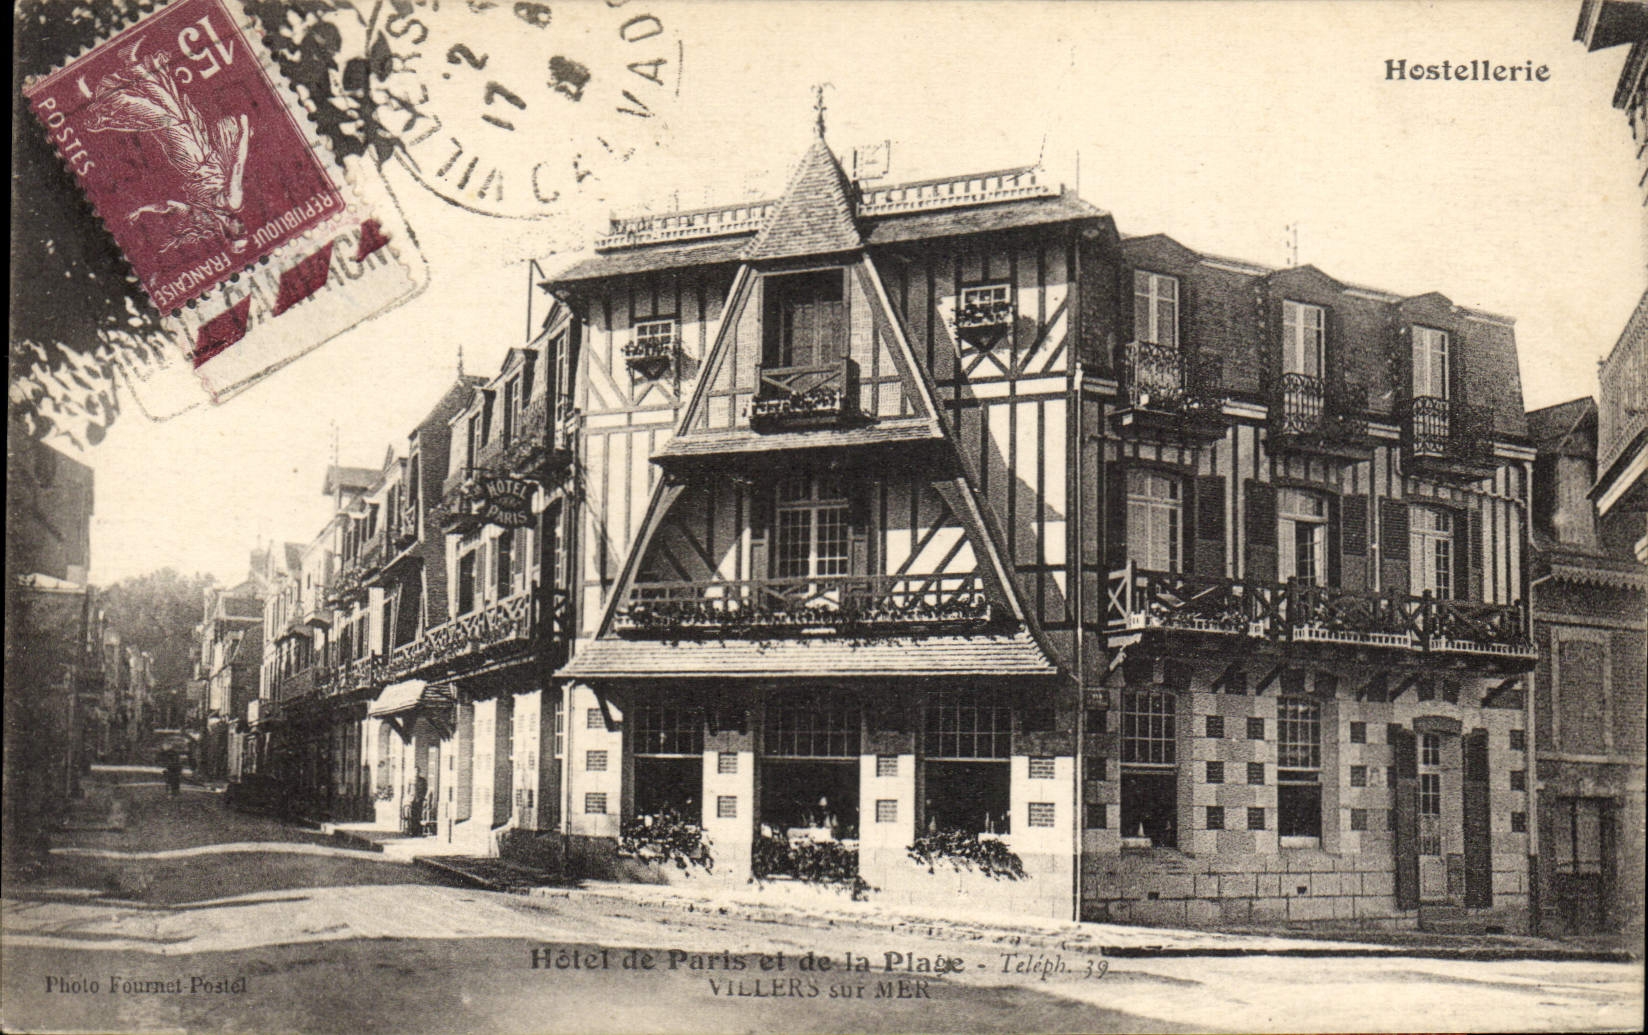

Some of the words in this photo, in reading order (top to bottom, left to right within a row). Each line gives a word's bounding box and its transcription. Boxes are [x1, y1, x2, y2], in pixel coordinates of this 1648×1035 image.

[178, 15, 234, 80] 15
[38, 97, 95, 176] POSTES
[253, 192, 334, 249] REPUBLIQUE
[154, 251, 232, 305] FRANÇAISE
[485, 504, 528, 525] PARIS
[486, 479, 527, 500] HOTEL
